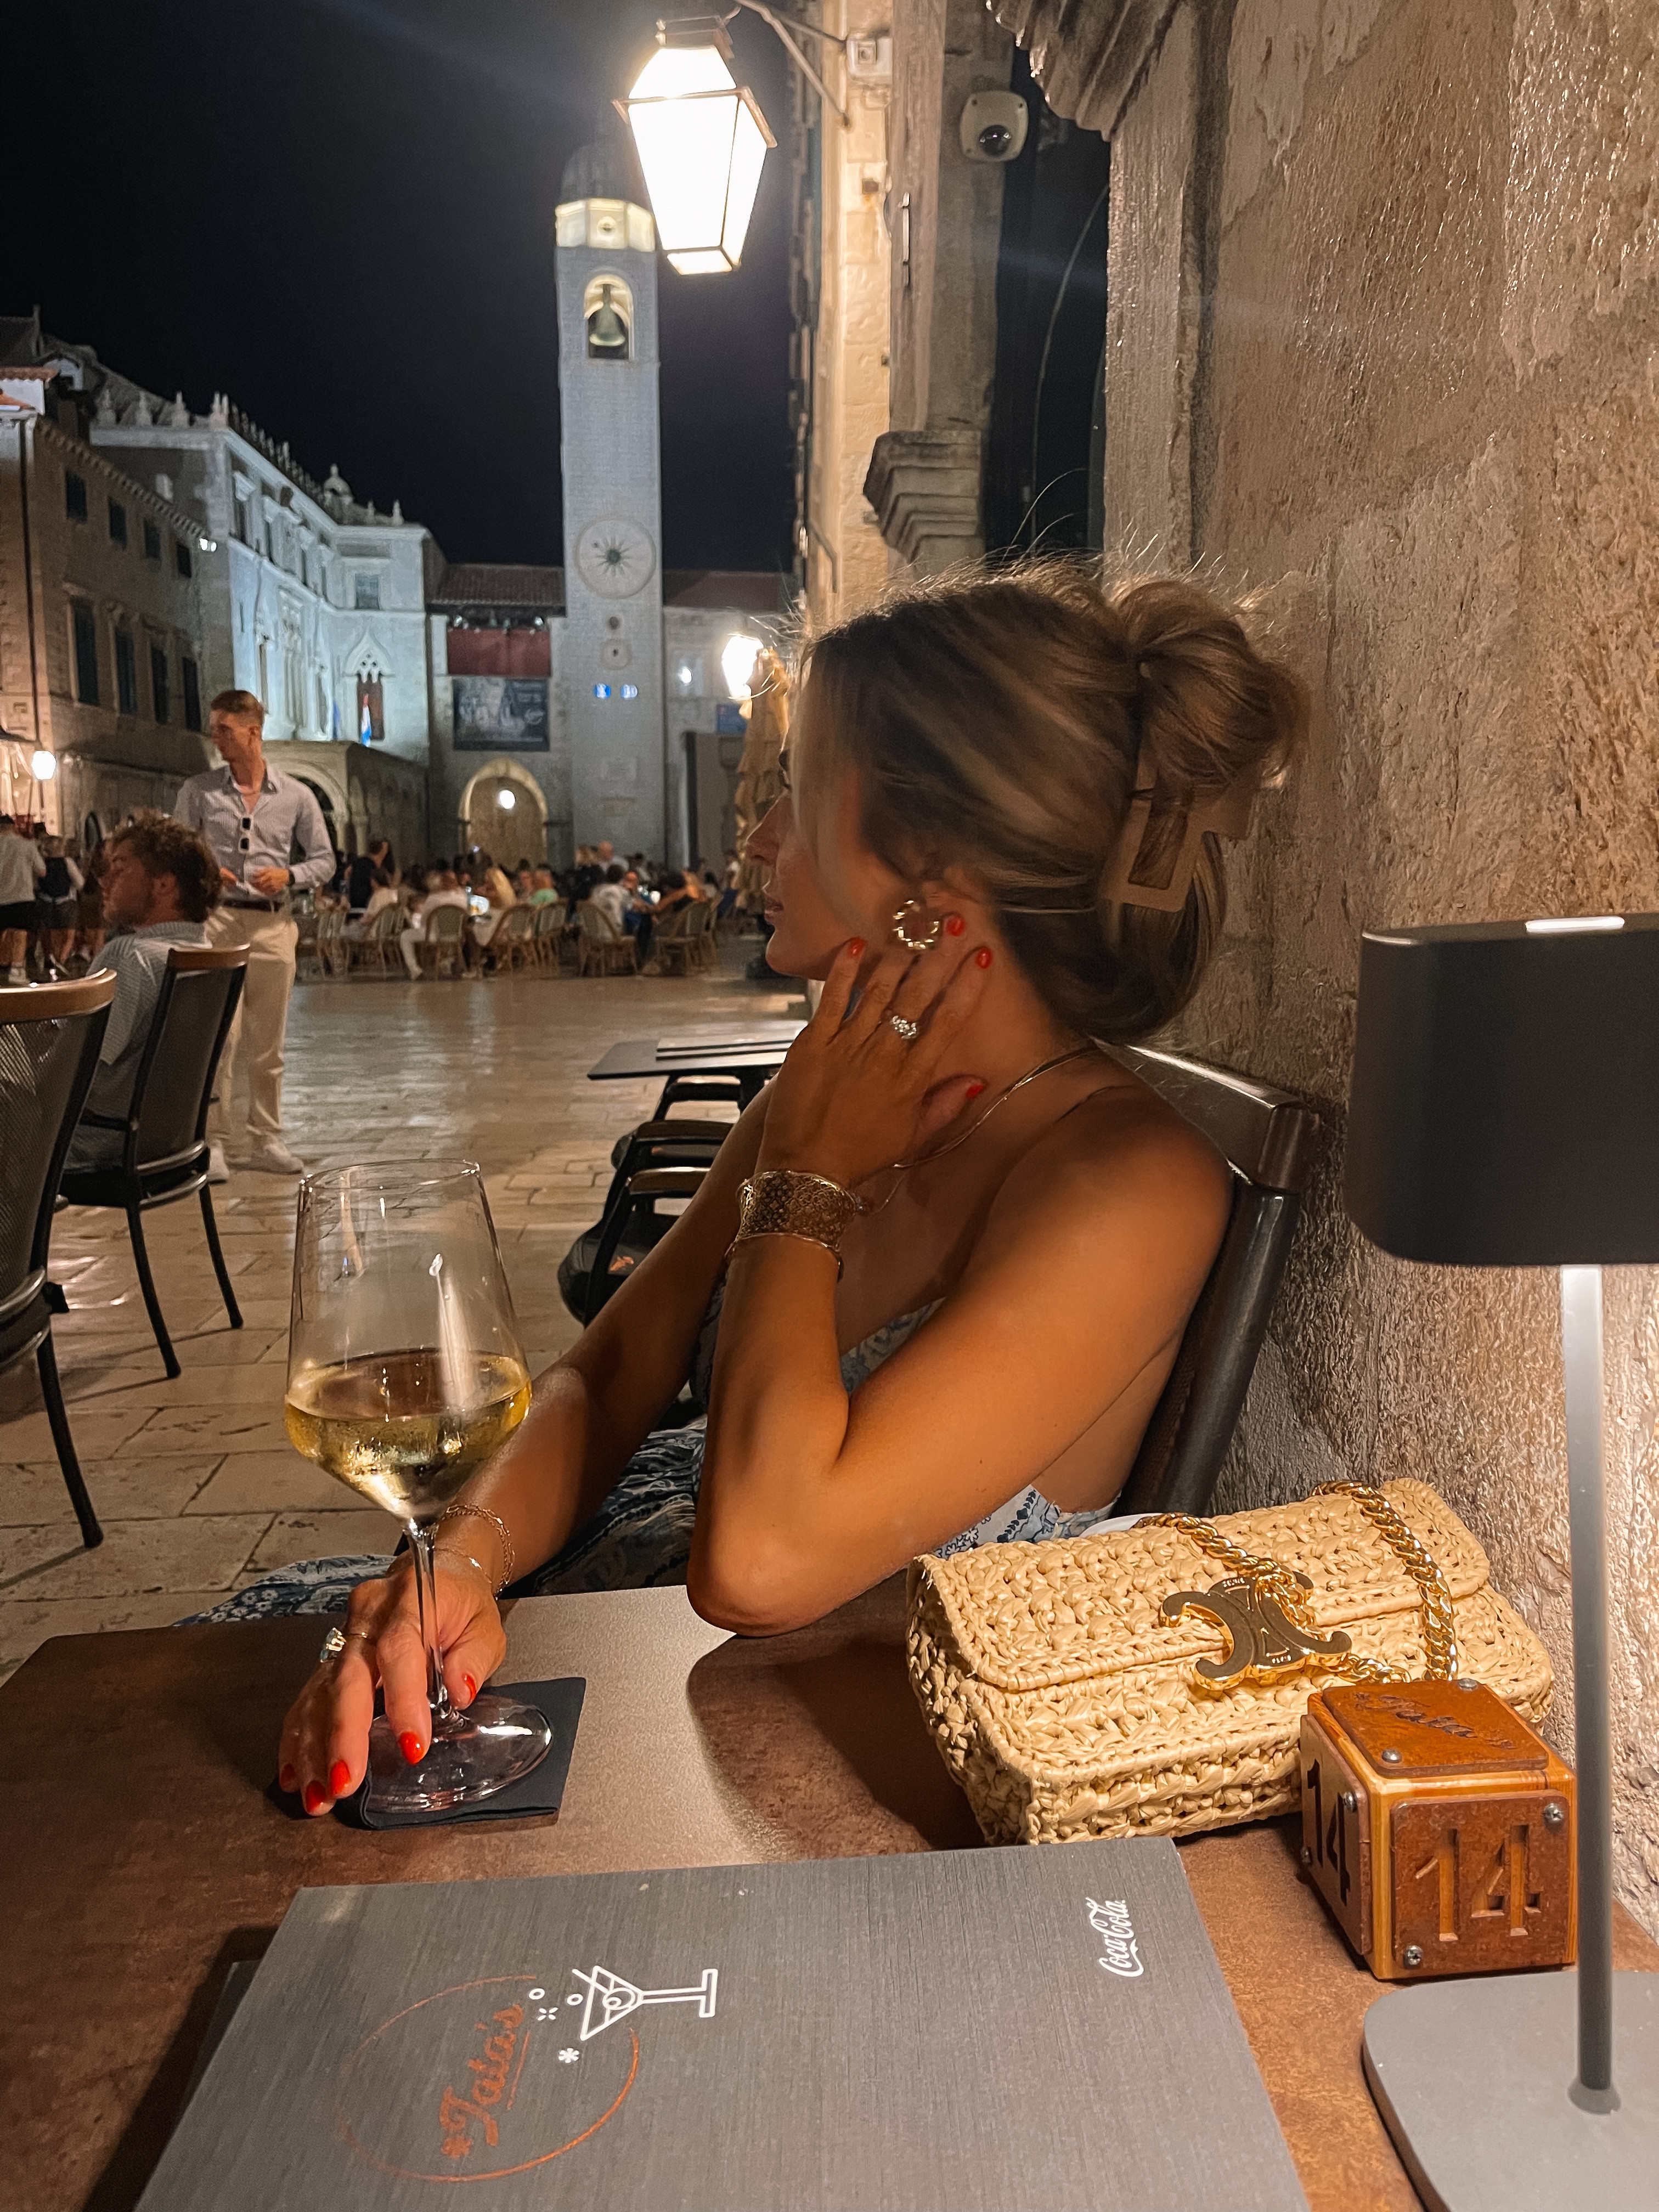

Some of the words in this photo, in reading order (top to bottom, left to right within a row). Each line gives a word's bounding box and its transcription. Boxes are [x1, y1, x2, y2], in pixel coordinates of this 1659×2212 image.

[1307, 1758, 1351, 1907] 14
[1415, 1824, 1542, 1942] 14
[1085, 1897, 1144, 1977] Coca-Cola
